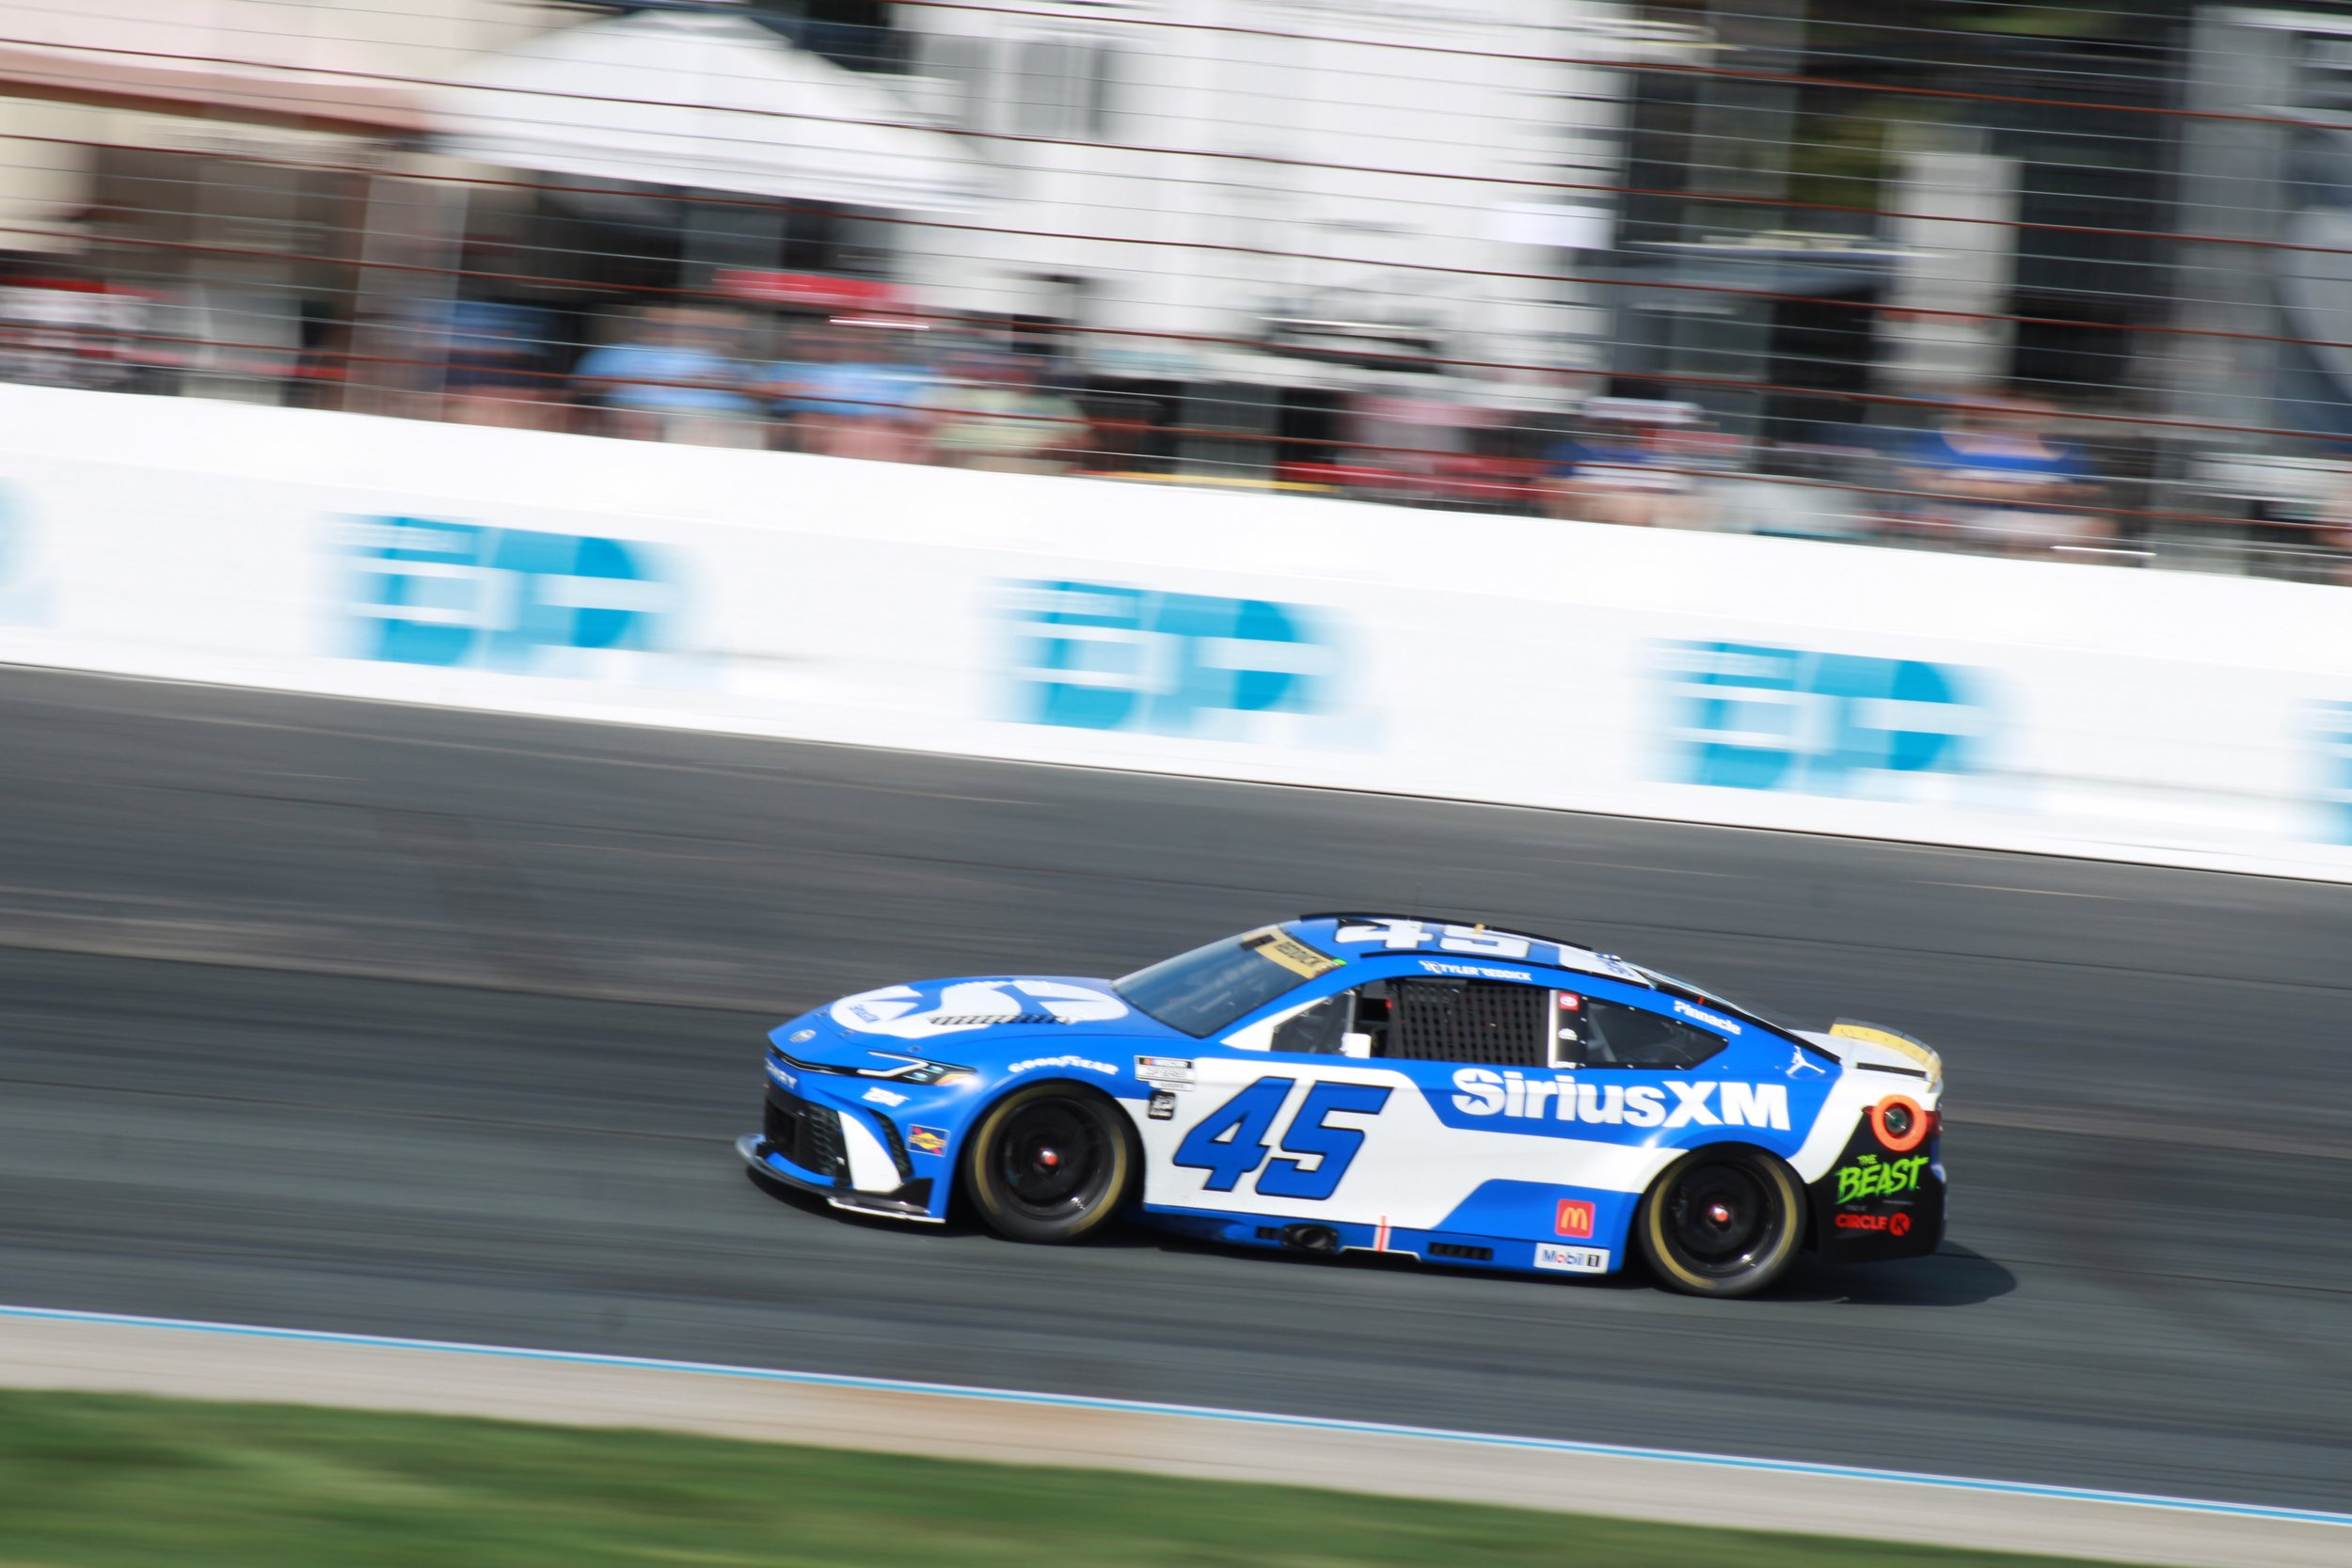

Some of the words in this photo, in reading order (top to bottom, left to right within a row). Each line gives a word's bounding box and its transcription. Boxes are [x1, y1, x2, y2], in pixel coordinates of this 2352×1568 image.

[1335, 918, 1531, 958] 45
[1440, 963, 1479, 975] TYLER
[1478, 967, 1533, 981] REDDICK
[1674, 1000, 1741, 1036] Pinnacle
[1452, 1068, 1791, 1132] SiriusXM
[1172, 1075, 1394, 1201] 45
[1856, 1153, 1878, 1165] THE
[1835, 1155, 1930, 1204] BEAST
[1836, 1212, 1888, 1231] CIRCLE
[1542, 1248, 1585, 1266] Mobil
[1587, 1254, 1600, 1268] 1
